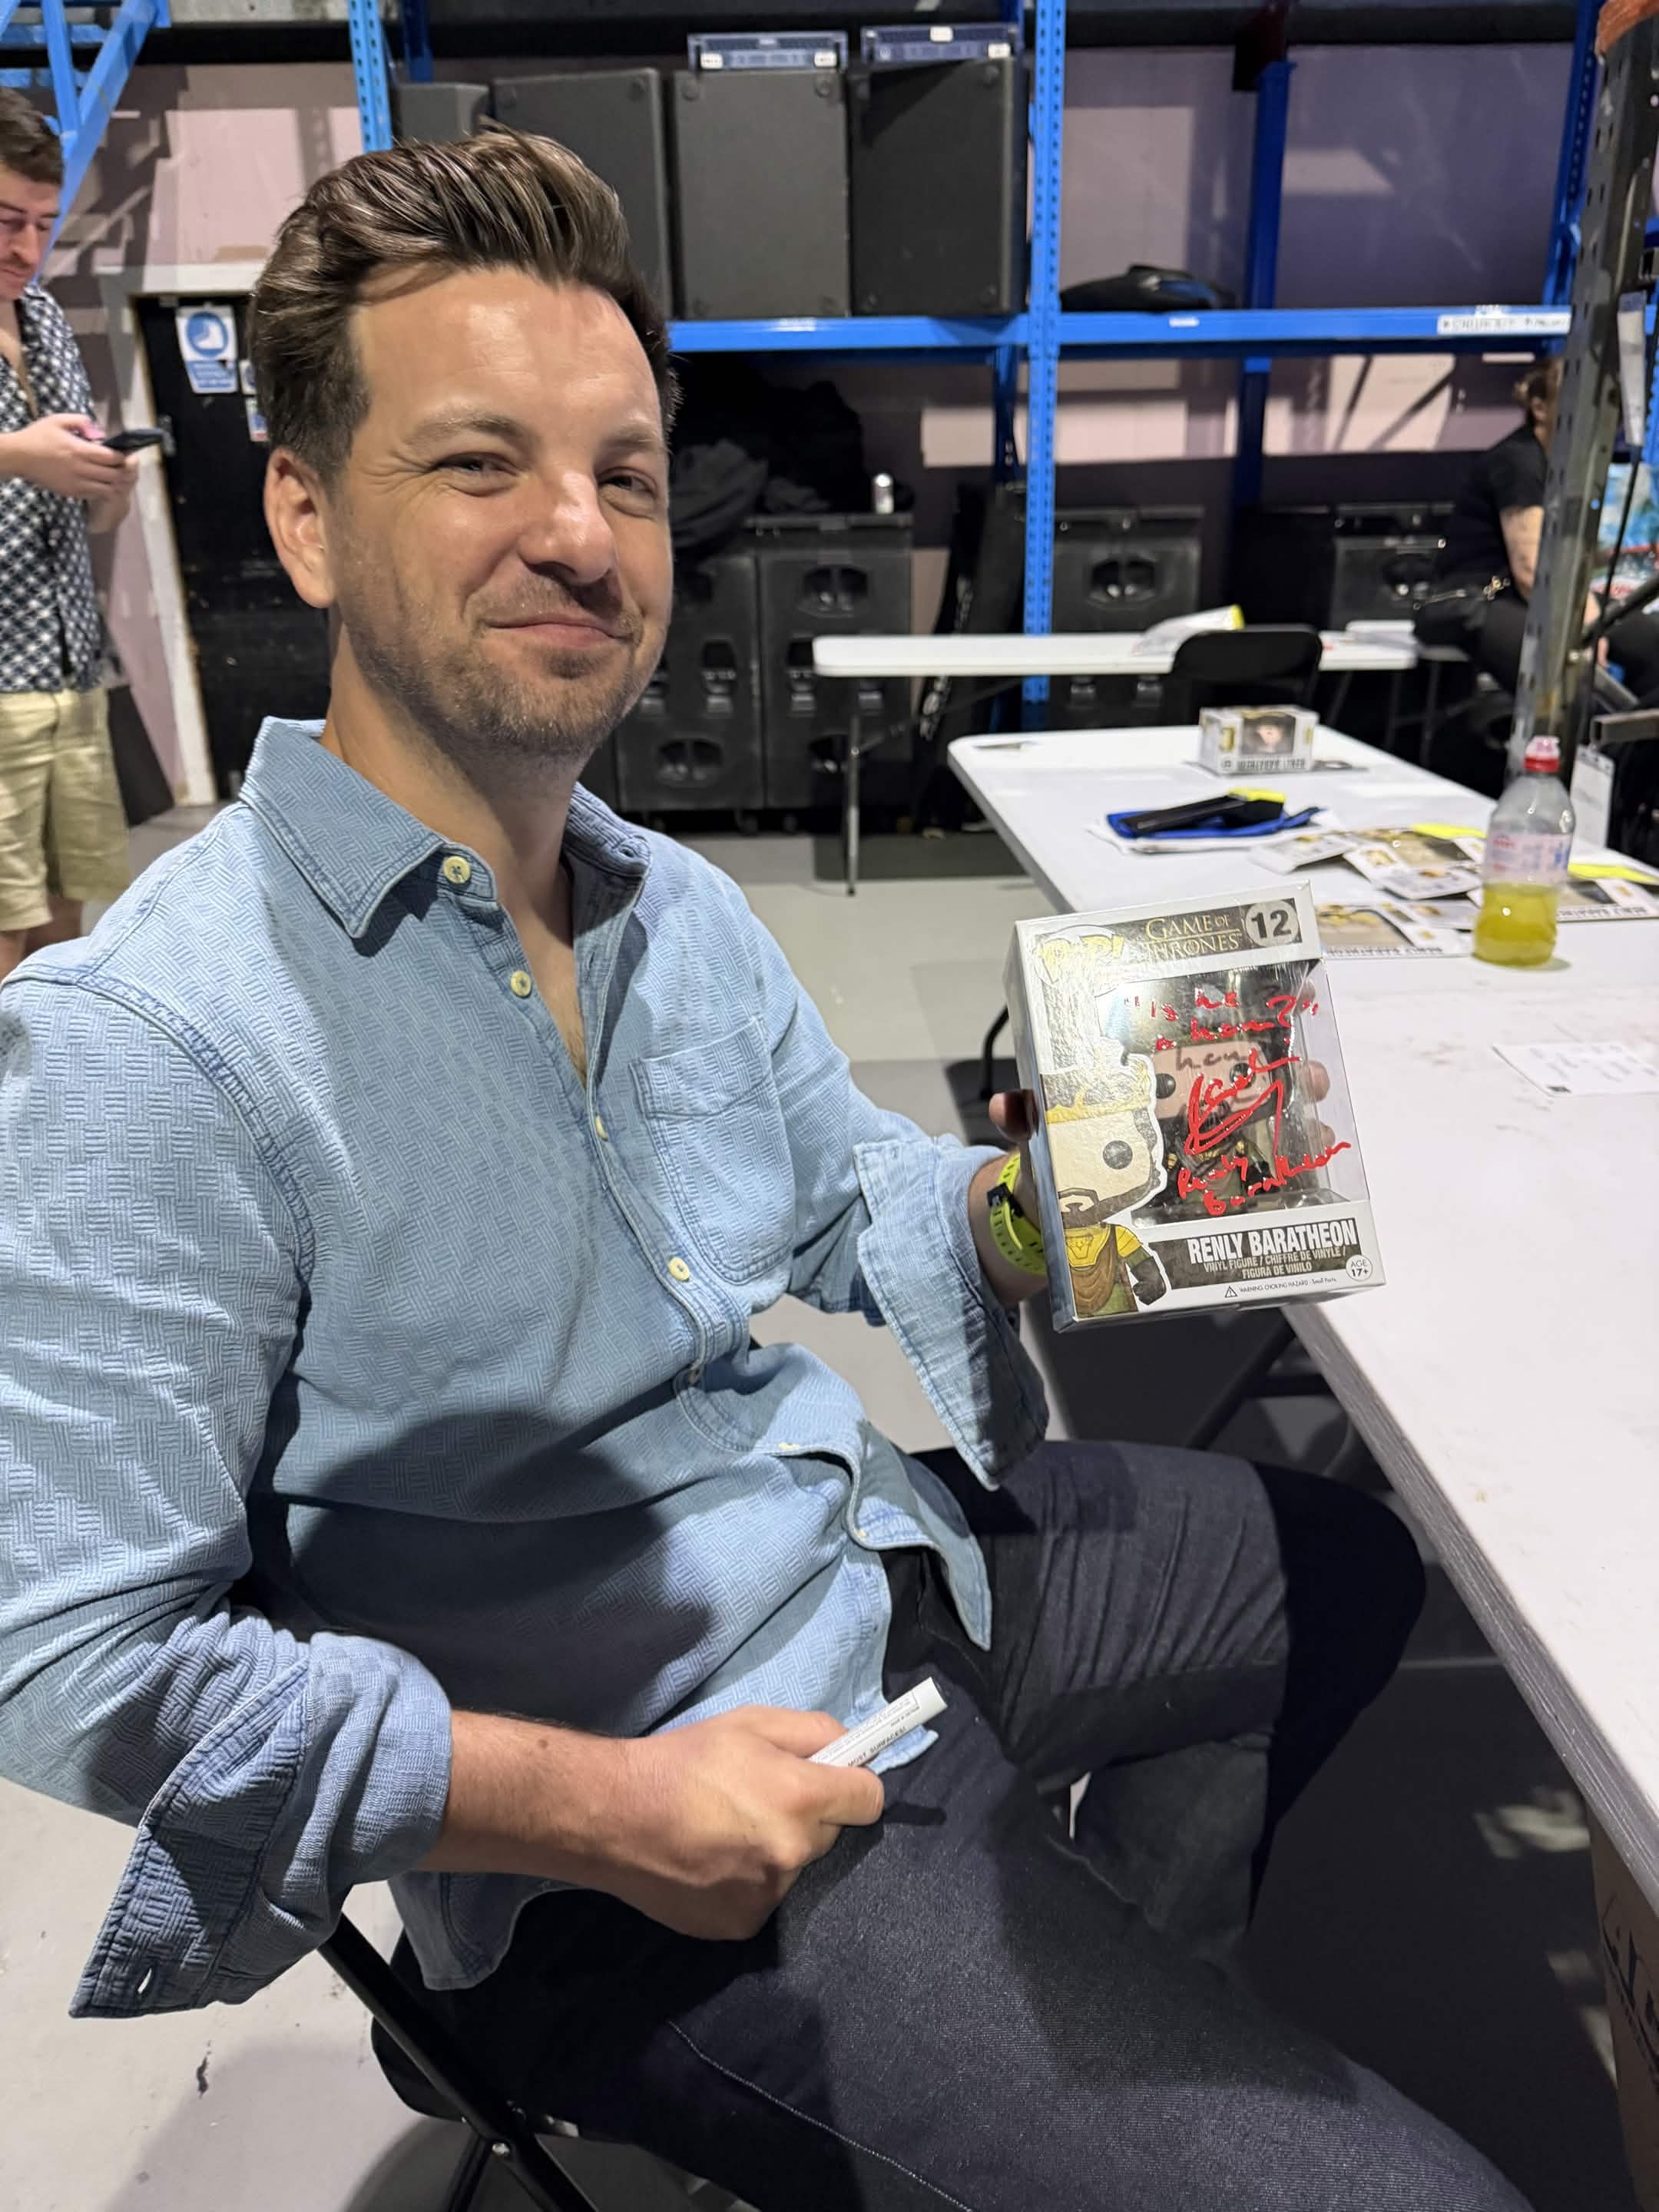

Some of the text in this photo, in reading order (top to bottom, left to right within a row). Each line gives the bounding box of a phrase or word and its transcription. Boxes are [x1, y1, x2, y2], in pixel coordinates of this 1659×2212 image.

[1145, 915, 1230, 941] GAME OF
[1251, 909, 1291, 939] 12
[1187, 1219, 1358, 1265] RENLY BARATHEON
[1204, 1260, 1228, 1273] VINYL
[1229, 1257, 1259, 1270] FIGURE
[1265, 1252, 1300, 1264] CHIFFRE
[1300, 1250, 1312, 1260] DE
[1312, 1247, 1341, 1260] VINYLE
[1242, 1261, 1312, 1279] FIGURA DE VINILO
[1352, 1268, 1369, 1277] 17+
